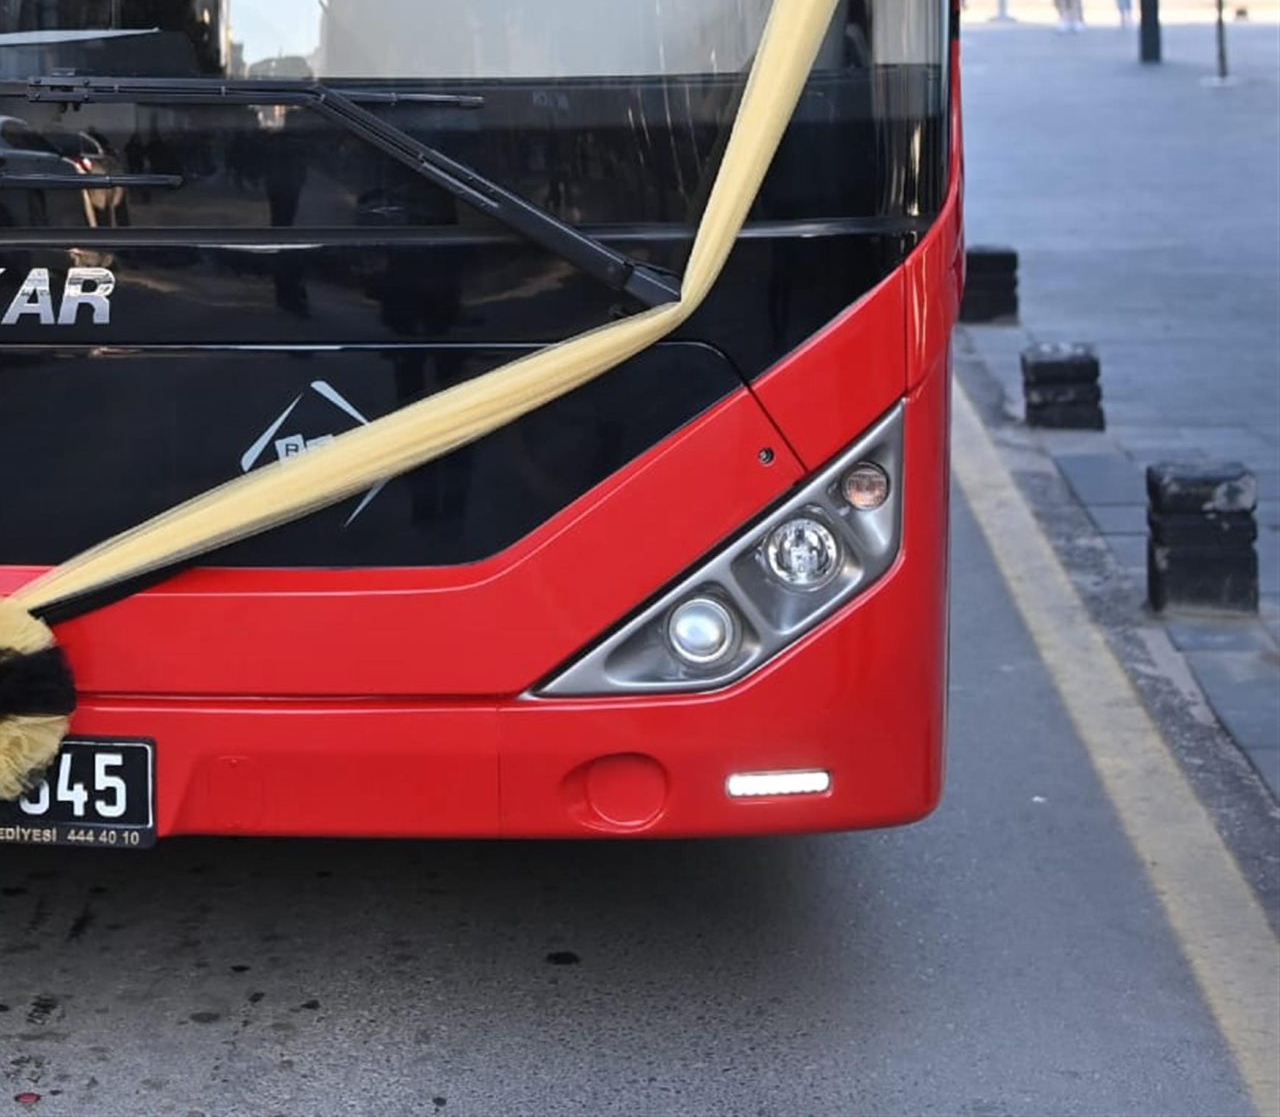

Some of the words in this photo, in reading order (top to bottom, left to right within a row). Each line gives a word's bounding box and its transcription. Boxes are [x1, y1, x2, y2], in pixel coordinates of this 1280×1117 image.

[67, 830, 95, 842] 444
[99, 831, 117, 843] 40
[123, 831, 140, 845] 10
